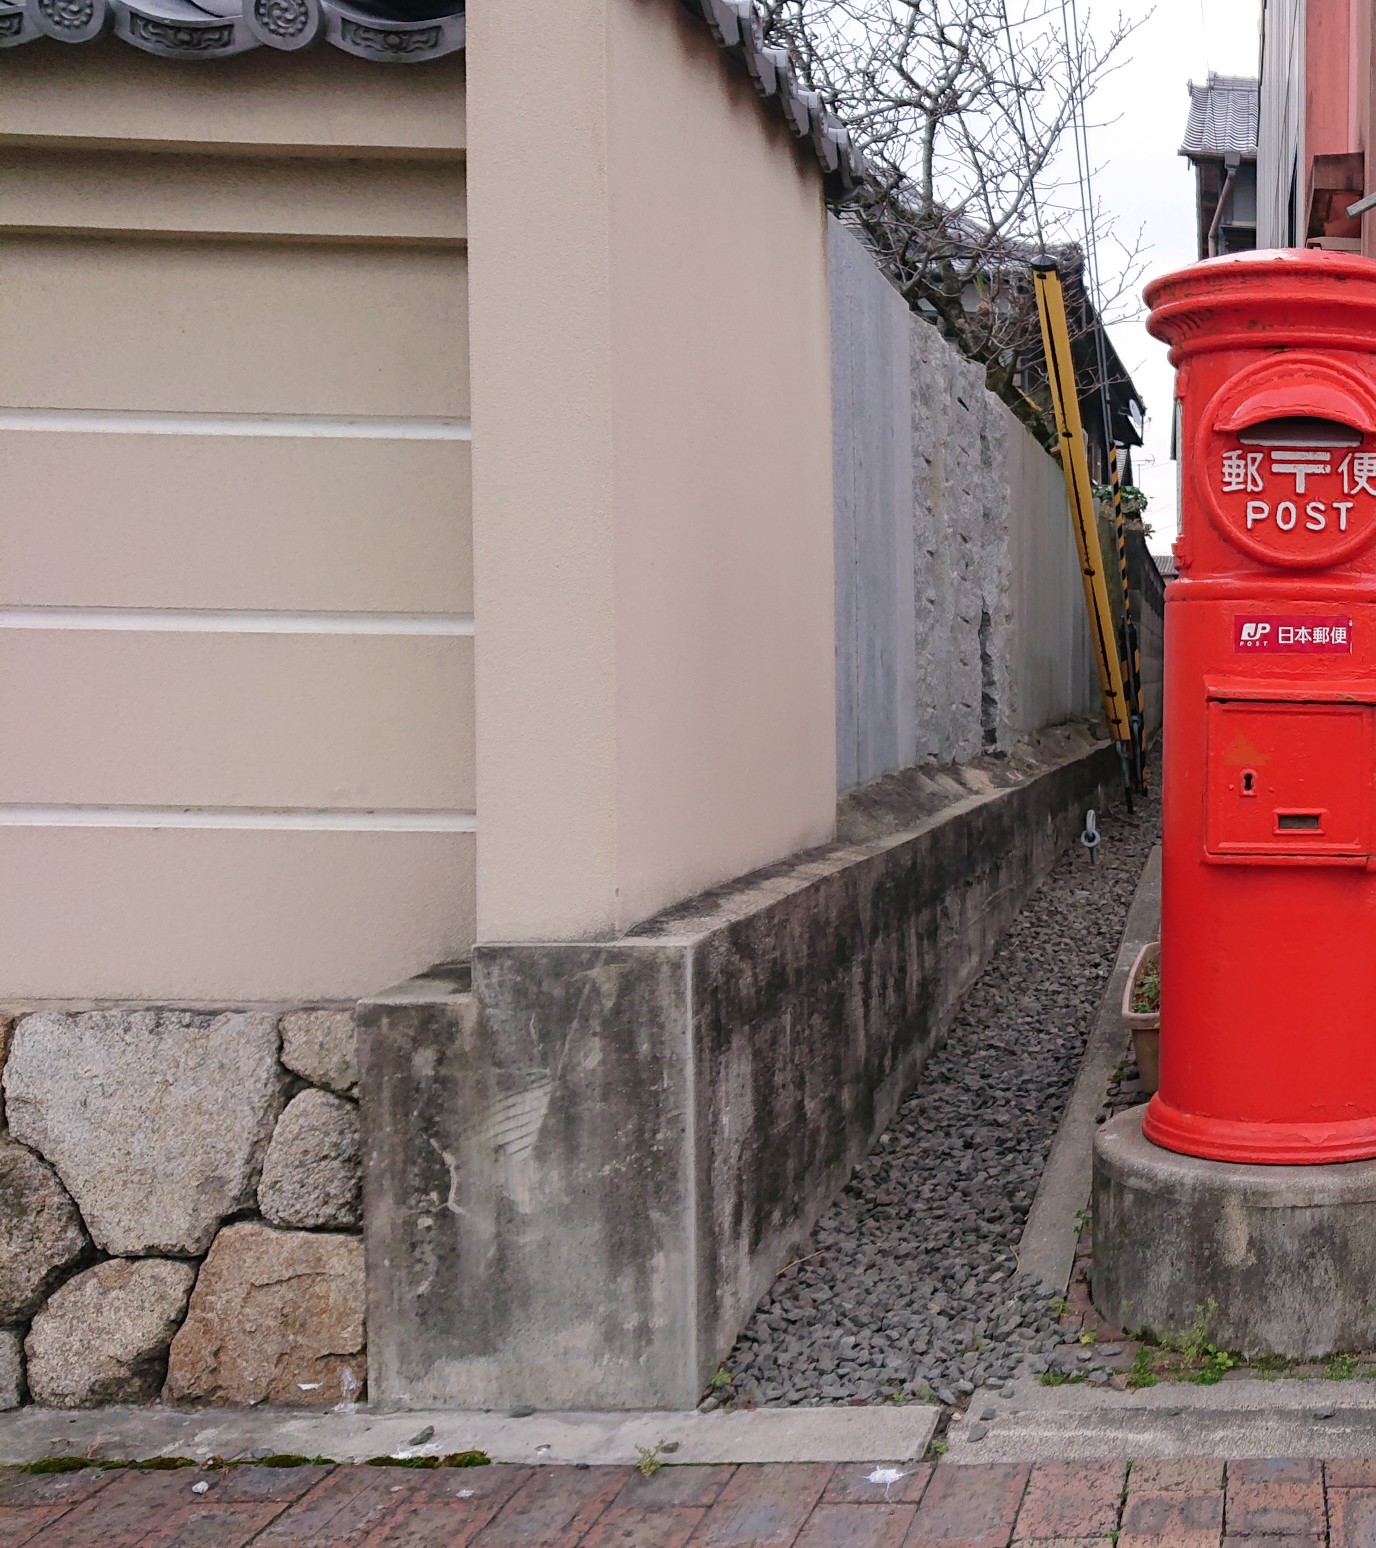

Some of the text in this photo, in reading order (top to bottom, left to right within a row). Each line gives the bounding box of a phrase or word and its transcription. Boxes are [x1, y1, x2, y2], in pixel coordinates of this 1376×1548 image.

[1246, 501, 1354, 531] POST
[1278, 626, 1347, 645] 日本郵便
